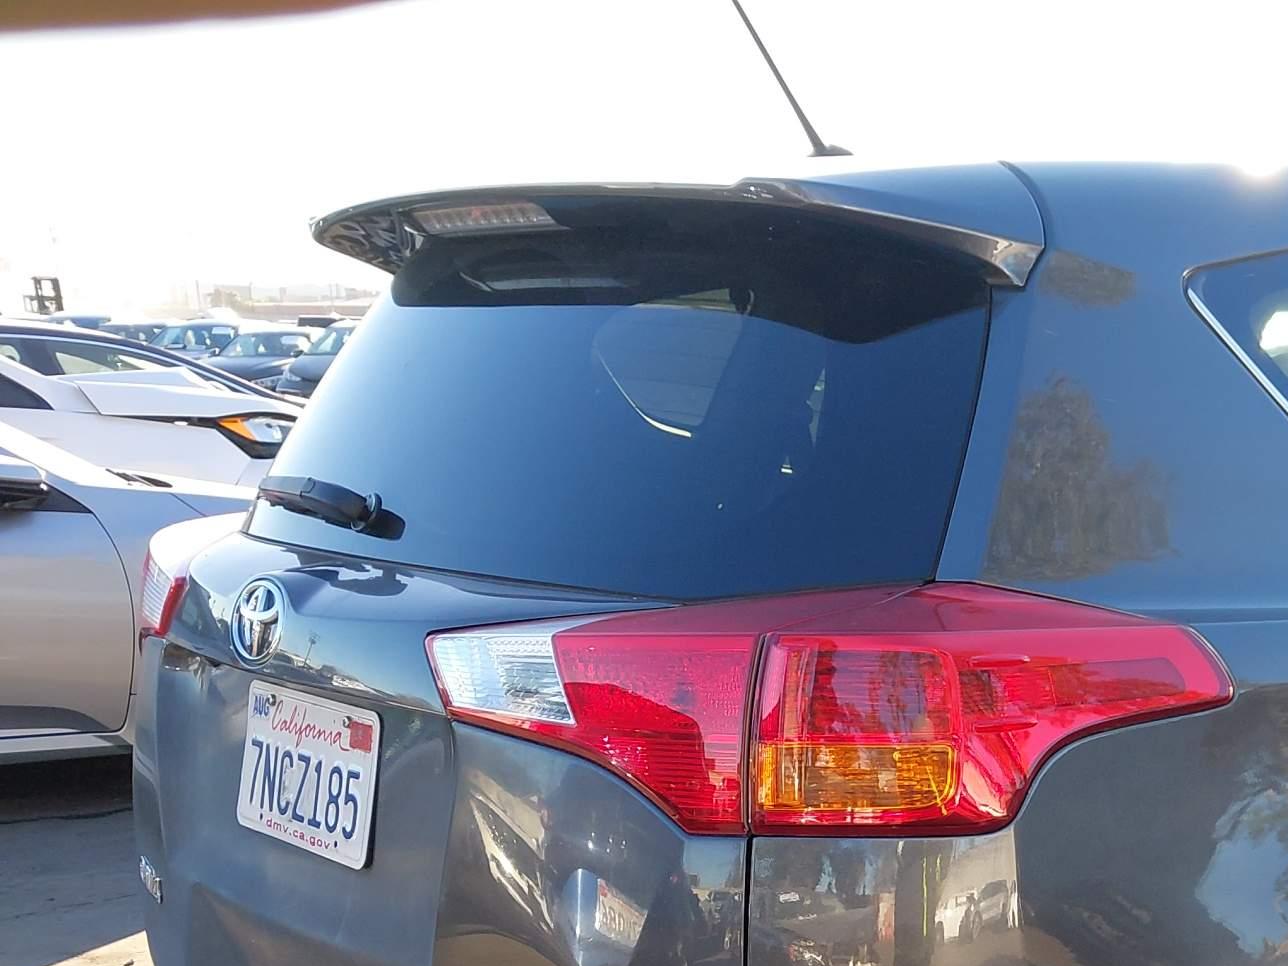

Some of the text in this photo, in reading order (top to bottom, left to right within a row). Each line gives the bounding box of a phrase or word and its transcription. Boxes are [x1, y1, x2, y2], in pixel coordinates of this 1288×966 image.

[253, 695, 271, 717] AUG
[271, 699, 350, 751] California
[249, 738, 360, 840] 7NCZ185
[265, 817, 331, 850] dmv.ca.gov
